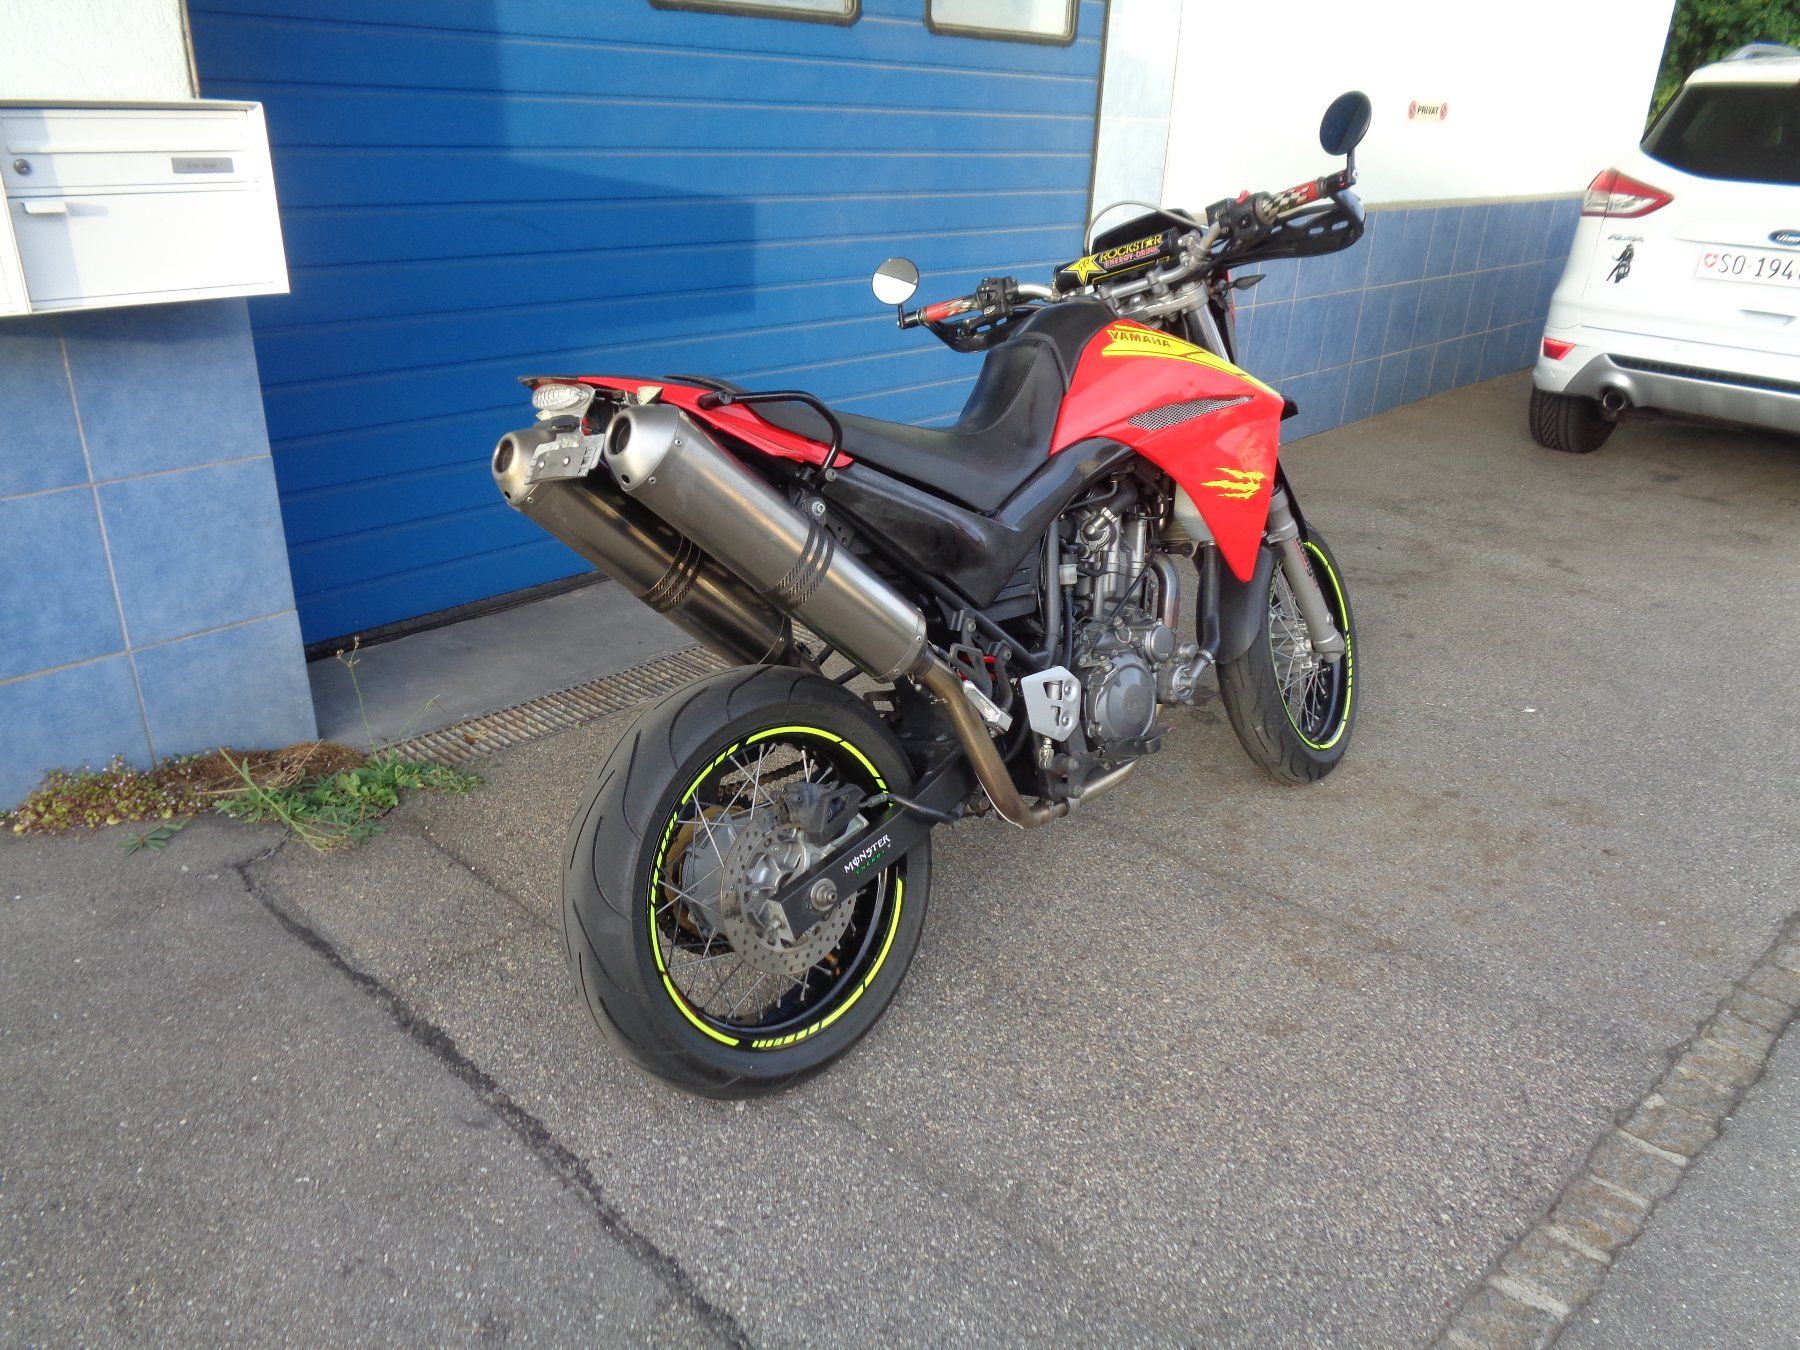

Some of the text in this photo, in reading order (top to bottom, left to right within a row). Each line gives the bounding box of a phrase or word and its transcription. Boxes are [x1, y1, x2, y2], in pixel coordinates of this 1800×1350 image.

[1417, 105, 1440, 115] PRIVAT
[1718, 253, 1800, 280] SO 194
[1109, 330, 1171, 348] YAMAHA
